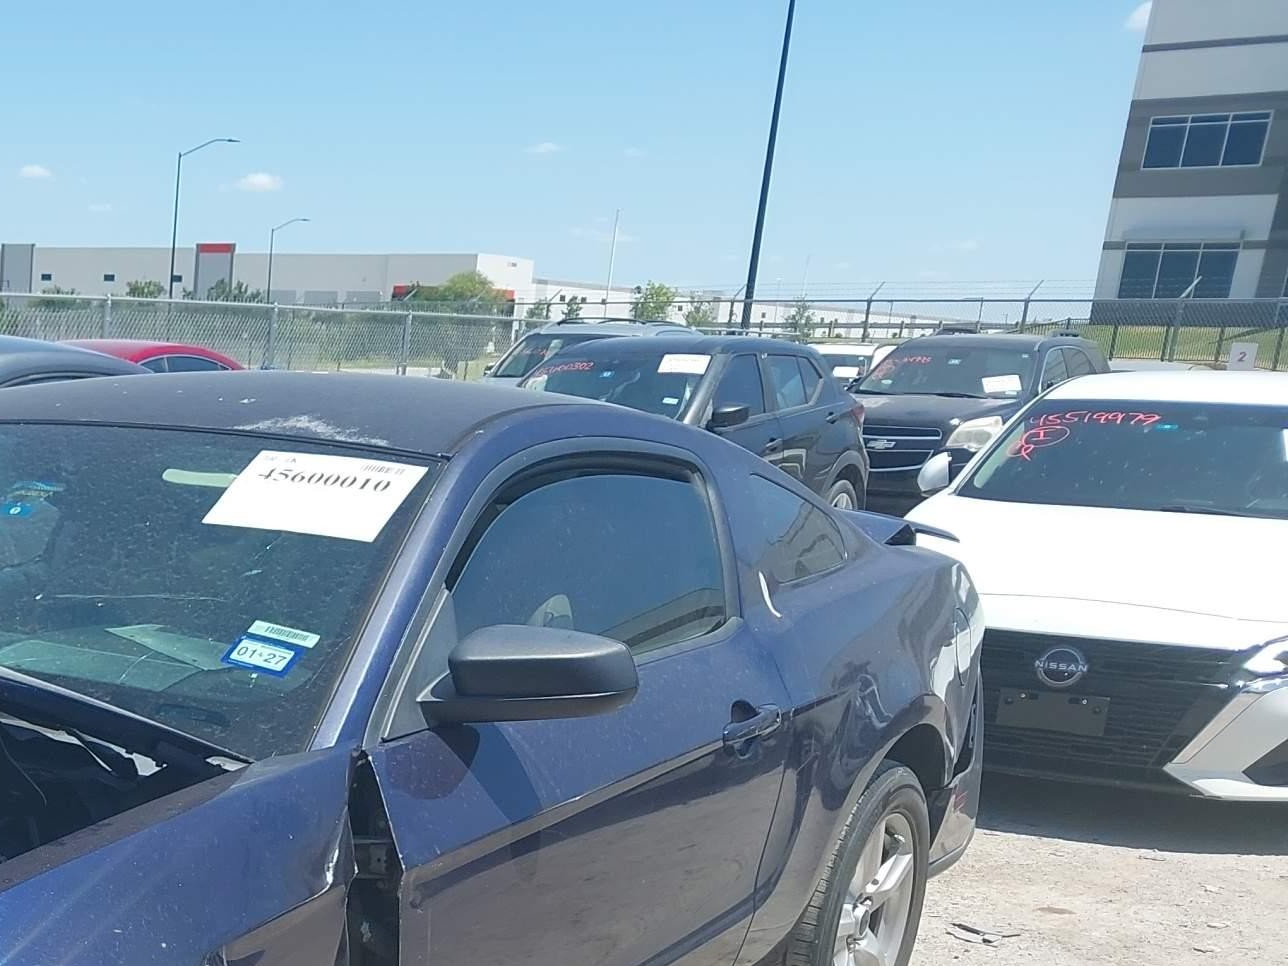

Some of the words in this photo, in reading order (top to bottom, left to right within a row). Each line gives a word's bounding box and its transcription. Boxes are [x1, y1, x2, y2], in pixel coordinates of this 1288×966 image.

[1237, 351, 1247, 362] 2
[1030, 410, 1162, 427] 45519979
[258, 467, 391, 492] 45600010
[1035, 659, 1088, 672] NISSAN
